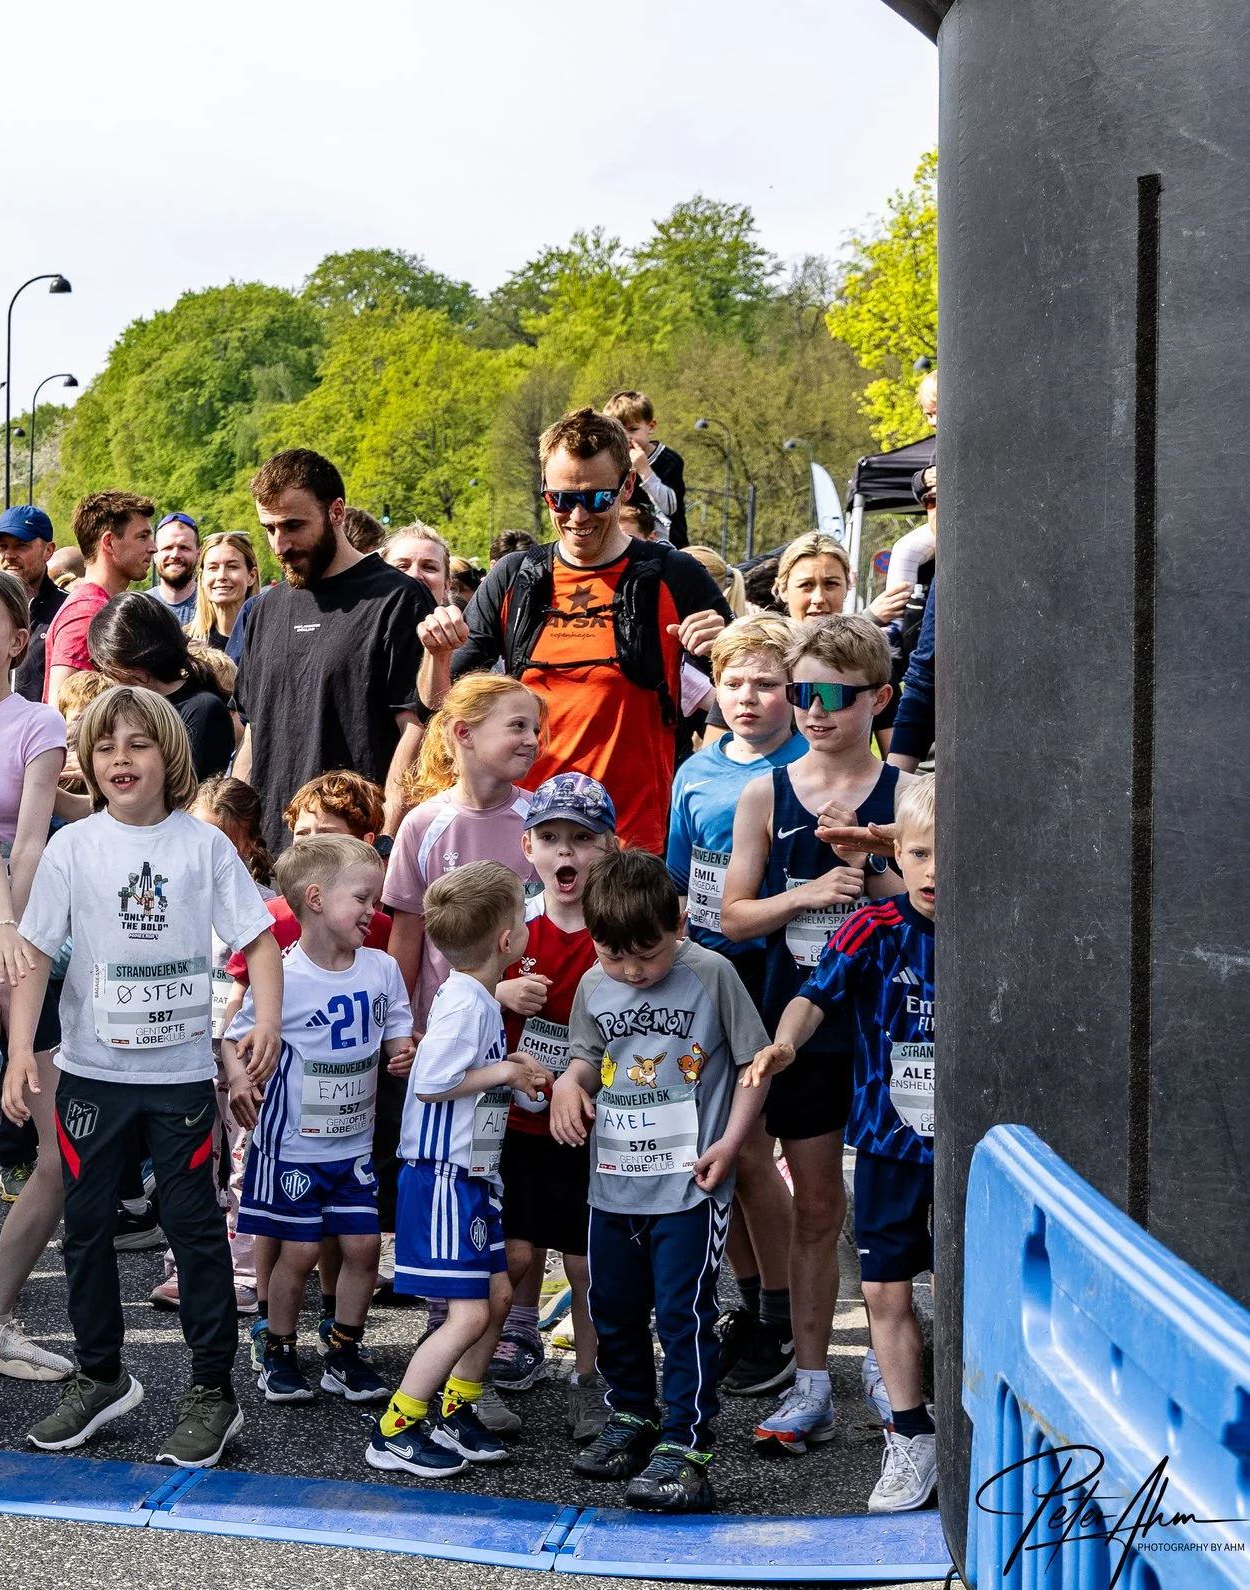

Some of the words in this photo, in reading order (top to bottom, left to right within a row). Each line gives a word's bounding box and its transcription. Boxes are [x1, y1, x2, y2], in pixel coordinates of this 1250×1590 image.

[694, 868, 717, 882] EMIL
[696, 893, 708, 906] 32
[148, 914, 165, 922] FOR
[828, 916, 846, 924] SPA
[121, 922, 138, 930] THE
[116, 963, 177, 977] STRANDVEJEN
[177, 962, 189, 974] 5K
[148, 1010, 174, 1023] 587
[327, 990, 370, 1050] 21
[136, 1023, 185, 1036] GENTOFTE
[530, 1018, 569, 1038] STRANDV
[136, 1032, 186, 1045] LØBEKLUB
[523, 1036, 569, 1056] CHRIST
[901, 1045, 934, 1058] STRAN
[312, 1059, 367, 1075] STRANDVEJEN
[318, 1080, 366, 1099] EMIL
[602, 1090, 655, 1106] STRANDVEJEN
[657, 1089, 670, 1102] 5K
[339, 1102, 360, 1115] 557
[326, 1113, 367, 1126] GENTOFTE
[603, 1109, 656, 1130] AXEL
[326, 1121, 367, 1134] LØBEKLUB
[629, 1139, 657, 1152] 576
[619, 1152, 673, 1163] GENTOFTE
[620, 1161, 675, 1172] LØBEKLUB
